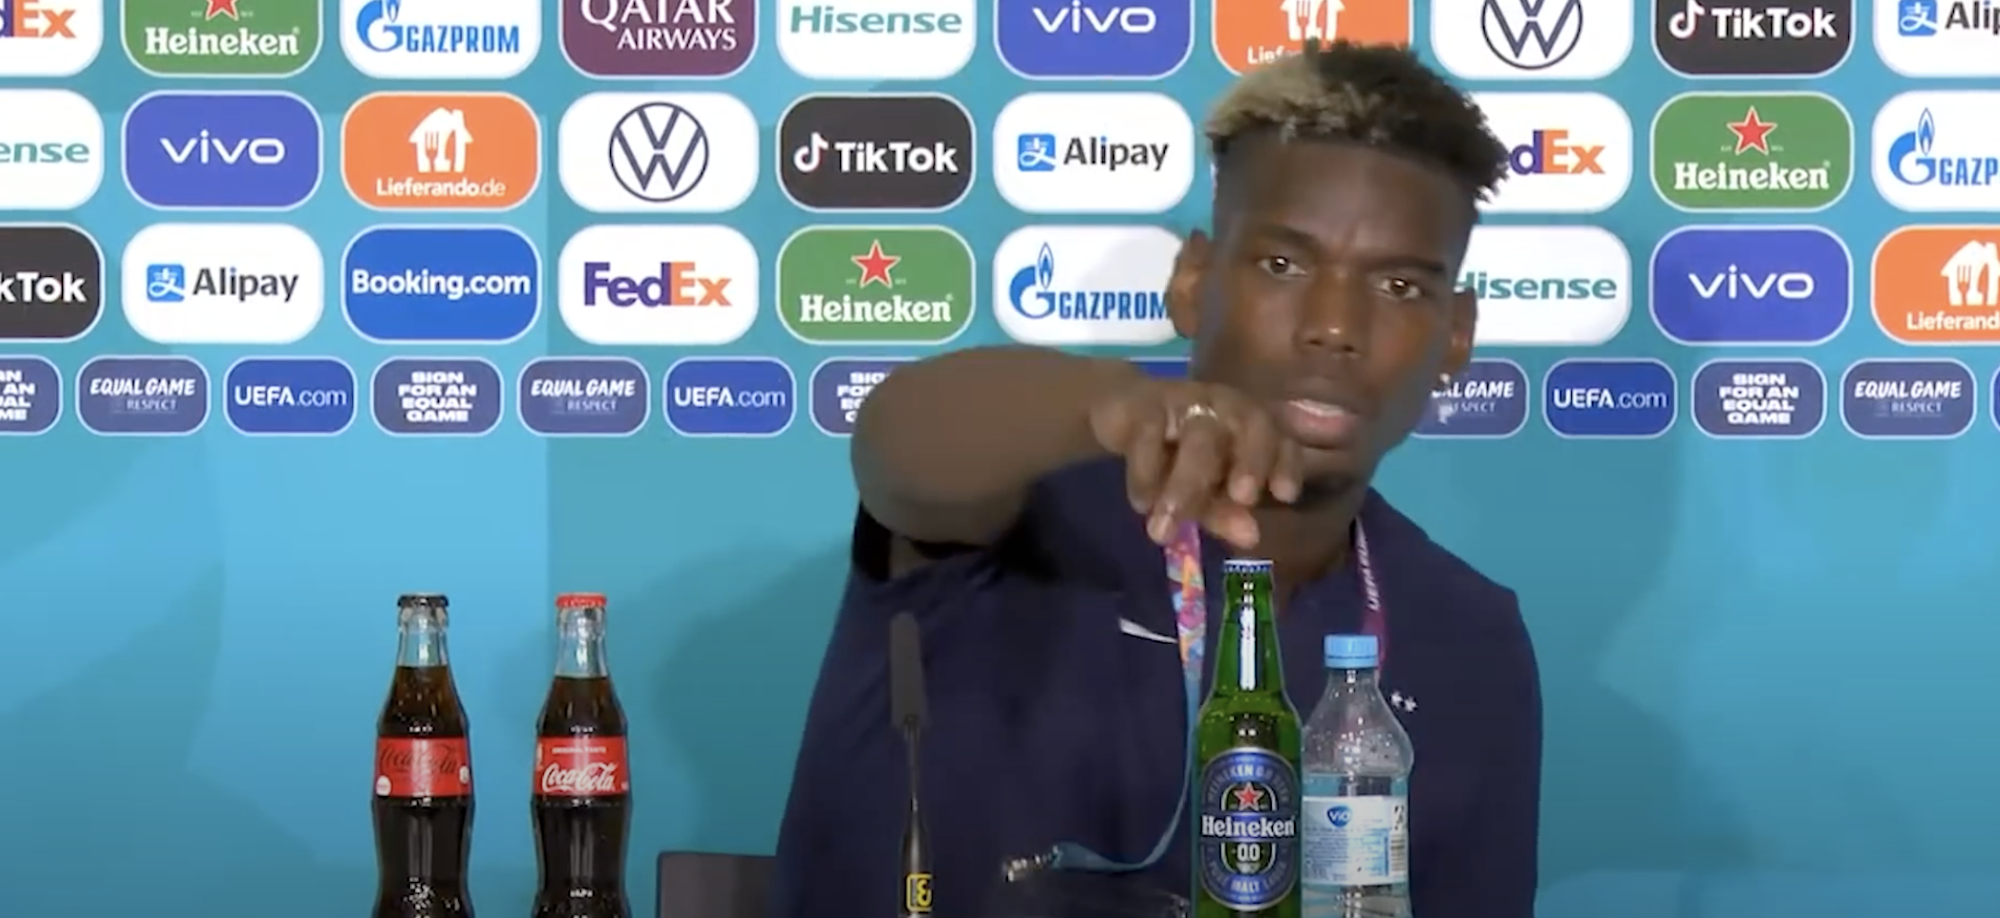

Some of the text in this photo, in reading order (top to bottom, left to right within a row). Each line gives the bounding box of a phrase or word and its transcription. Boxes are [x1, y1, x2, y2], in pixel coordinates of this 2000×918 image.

[790, 6, 962, 34] Hisense
[1033, 0, 1156, 33] vivo
[1712, 6, 1837, 39] TikTok
[145, 26, 300, 55] Heineken
[406, 25, 520, 53] GAZPROM
[617, 28, 737, 51] AIRWAYS
[160, 129, 285, 164] vivo
[835, 141, 958, 173] TikTok
[1063, 136, 1169, 170] Alipay
[377, 178, 506, 196] Lieferando.de
[1673, 162, 1830, 190] Heineken
[193, 266, 299, 302] Alipay
[352, 269, 531, 300] Booking.com
[584, 261, 732, 307] FedEx
[1688, 264, 1815, 298] vivo
[800, 294, 952, 323] Heineken
[90, 378, 196, 396] EQUAL GAME
[411, 371, 464, 384] SIGN
[530, 379, 636, 397] EQUAL GAME
[1732, 373, 1786, 386] SIGN
[3, 383, 36, 396] AN
[234, 385, 347, 407] UEFA.com
[398, 384, 477, 397] FOR AN
[674, 386, 786, 408] UEFA.com
[1464, 381, 1515, 399] GAME
[1553, 388, 1667, 408] UEFA.com
[1719, 386, 1799, 399] FOR AN
[1854, 380, 1962, 399] EQUAL GAME
[402, 397, 473, 411] EQUAL
[1723, 399, 1795, 413] EQUAL
[406, 410, 469, 422] GAME
[1727, 412, 1791, 425] GAME
[1202, 815, 1295, 837] Heineken
